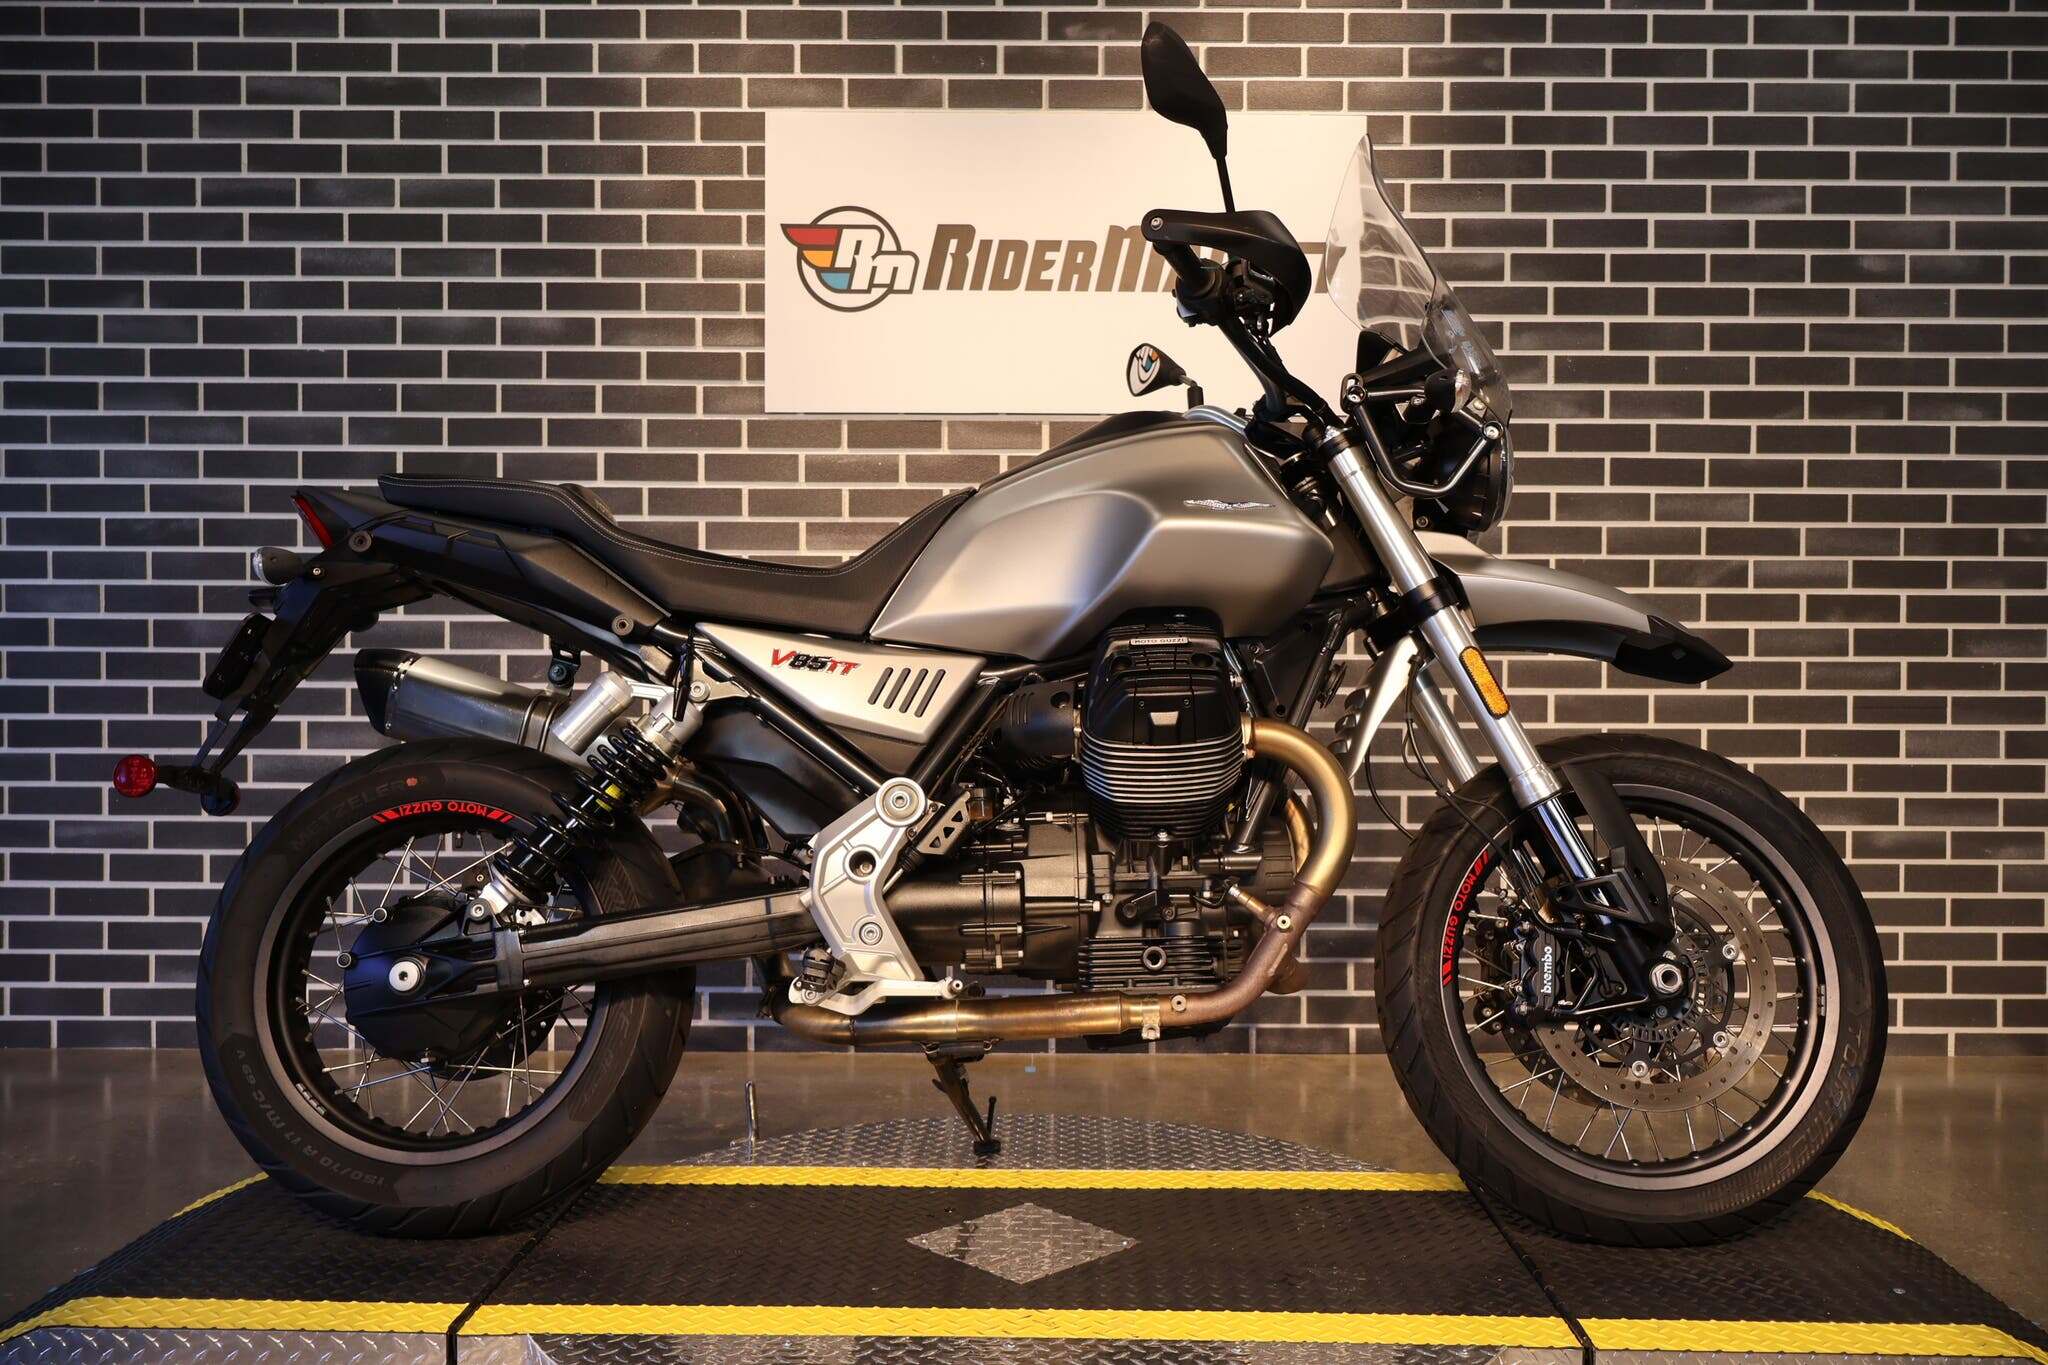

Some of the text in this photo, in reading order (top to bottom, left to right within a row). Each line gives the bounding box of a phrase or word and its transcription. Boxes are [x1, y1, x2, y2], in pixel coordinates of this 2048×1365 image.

[771, 648, 861, 676] V85TT
[399, 801, 488, 817] MOTO GUZZI
[1443, 873, 1477, 959] MOTO GUZZI
[1540, 945, 1553, 994] brembo
